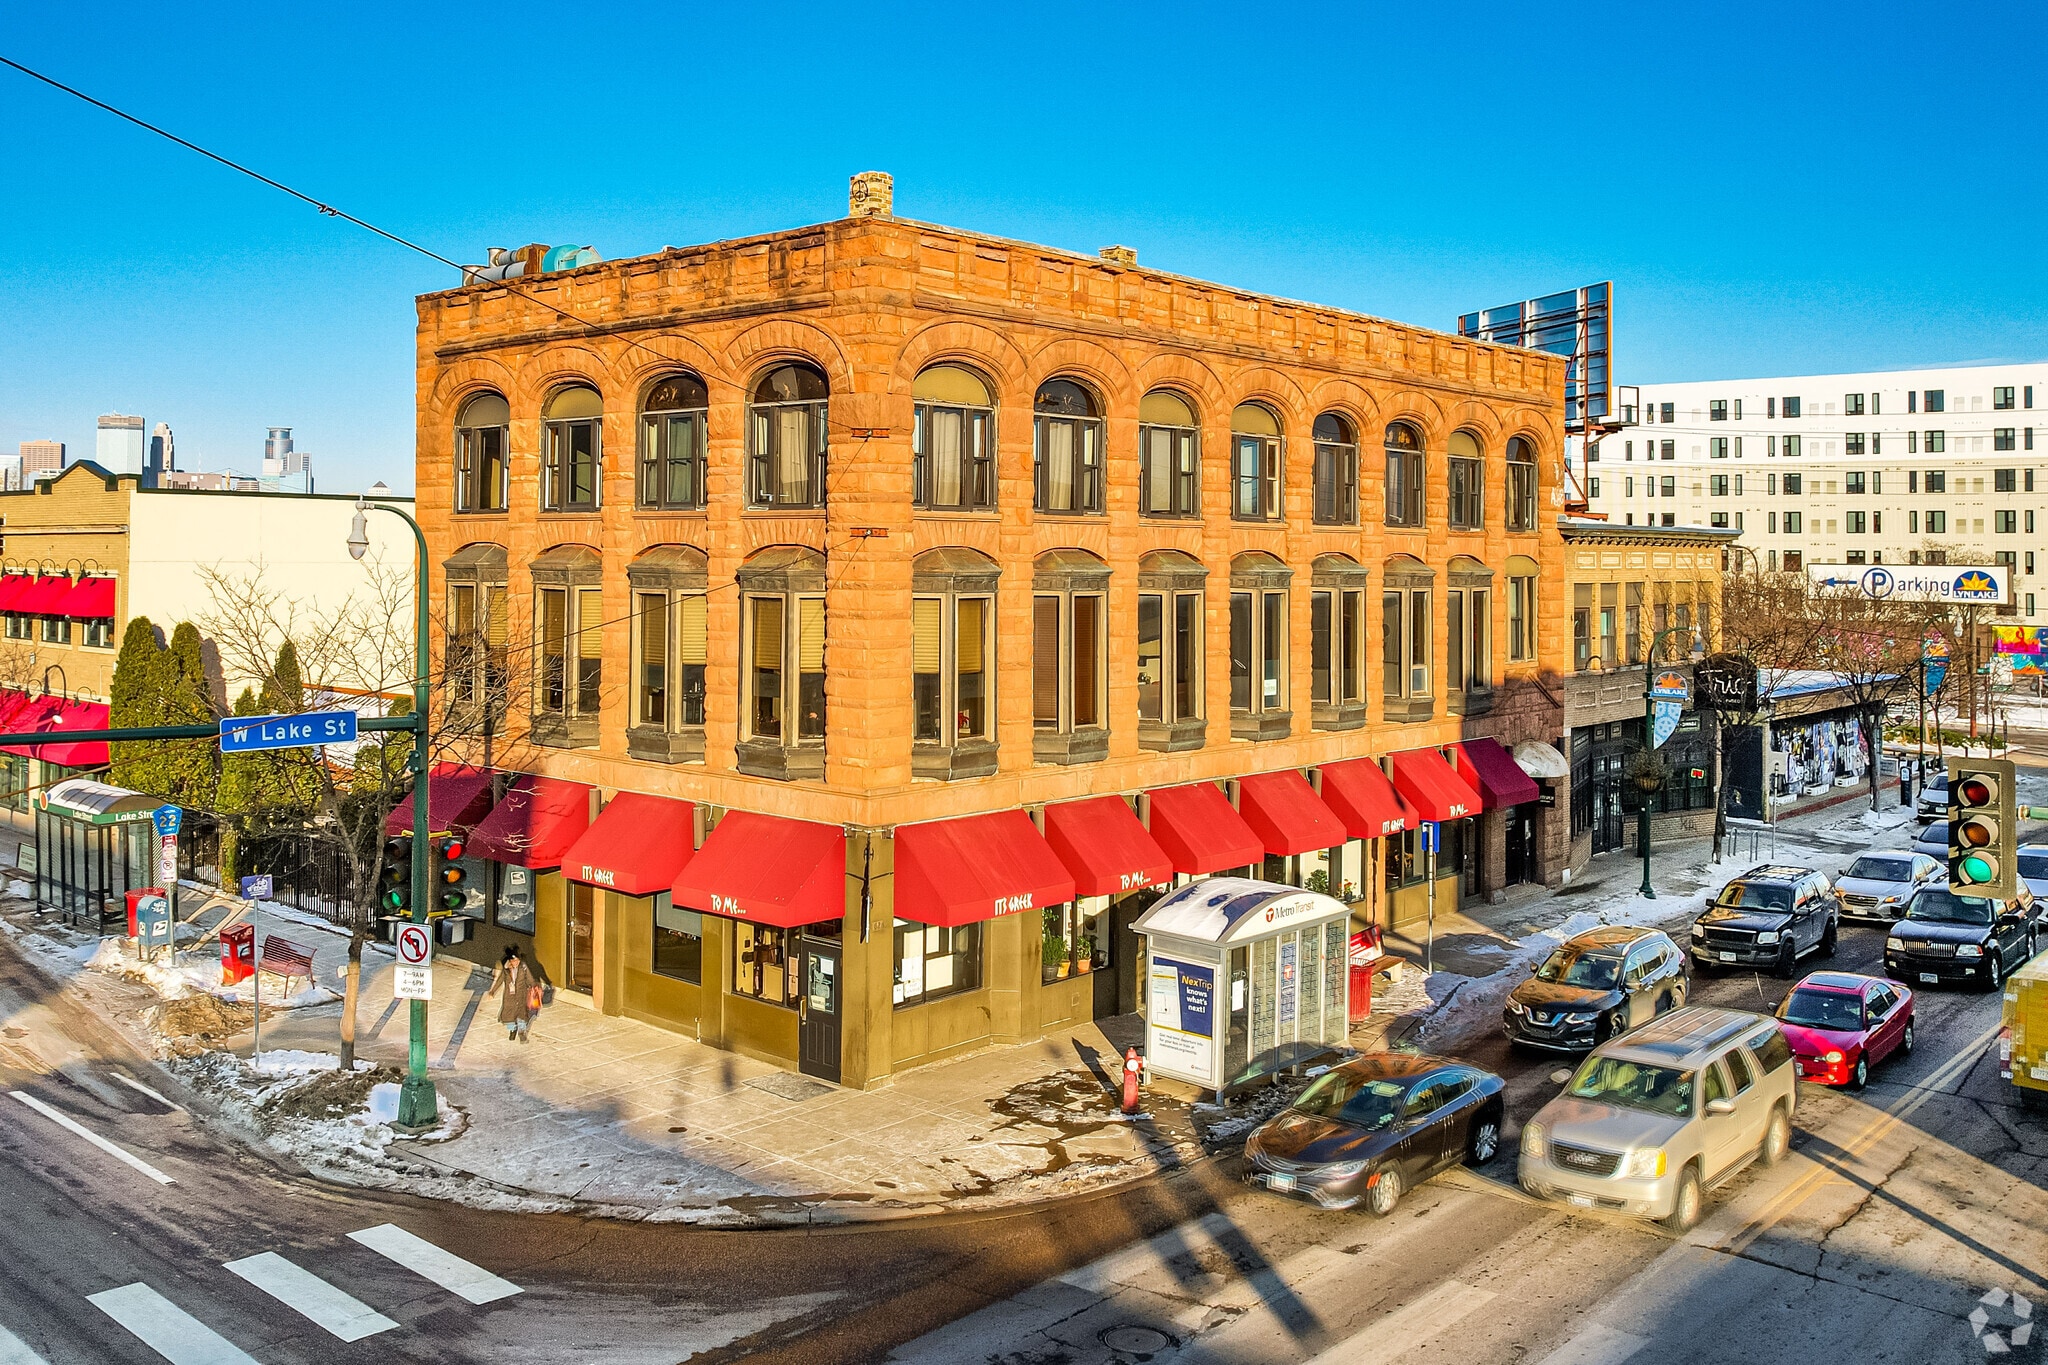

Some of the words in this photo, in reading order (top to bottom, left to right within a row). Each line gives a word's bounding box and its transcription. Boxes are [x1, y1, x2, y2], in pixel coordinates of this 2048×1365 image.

[1953, 591, 1998, 599] LYNLAKE
[232, 726, 248, 743] W
[261, 723, 312, 741] Lake
[324, 719, 347, 736] St
[115, 812, 137, 822] Lake
[159, 814, 177, 828] 22
[594, 868, 615, 887] GREEK
[1120, 875, 1130, 890] TO
[711, 895, 722, 912] TO
[1008, 892, 1033, 912] GREEK
[1181, 975, 1213, 992] NexTrip
[1186, 986, 1208, 998] knows
[1186, 996, 1208, 1006] what's
[1187, 1004, 1206, 1014] next!
